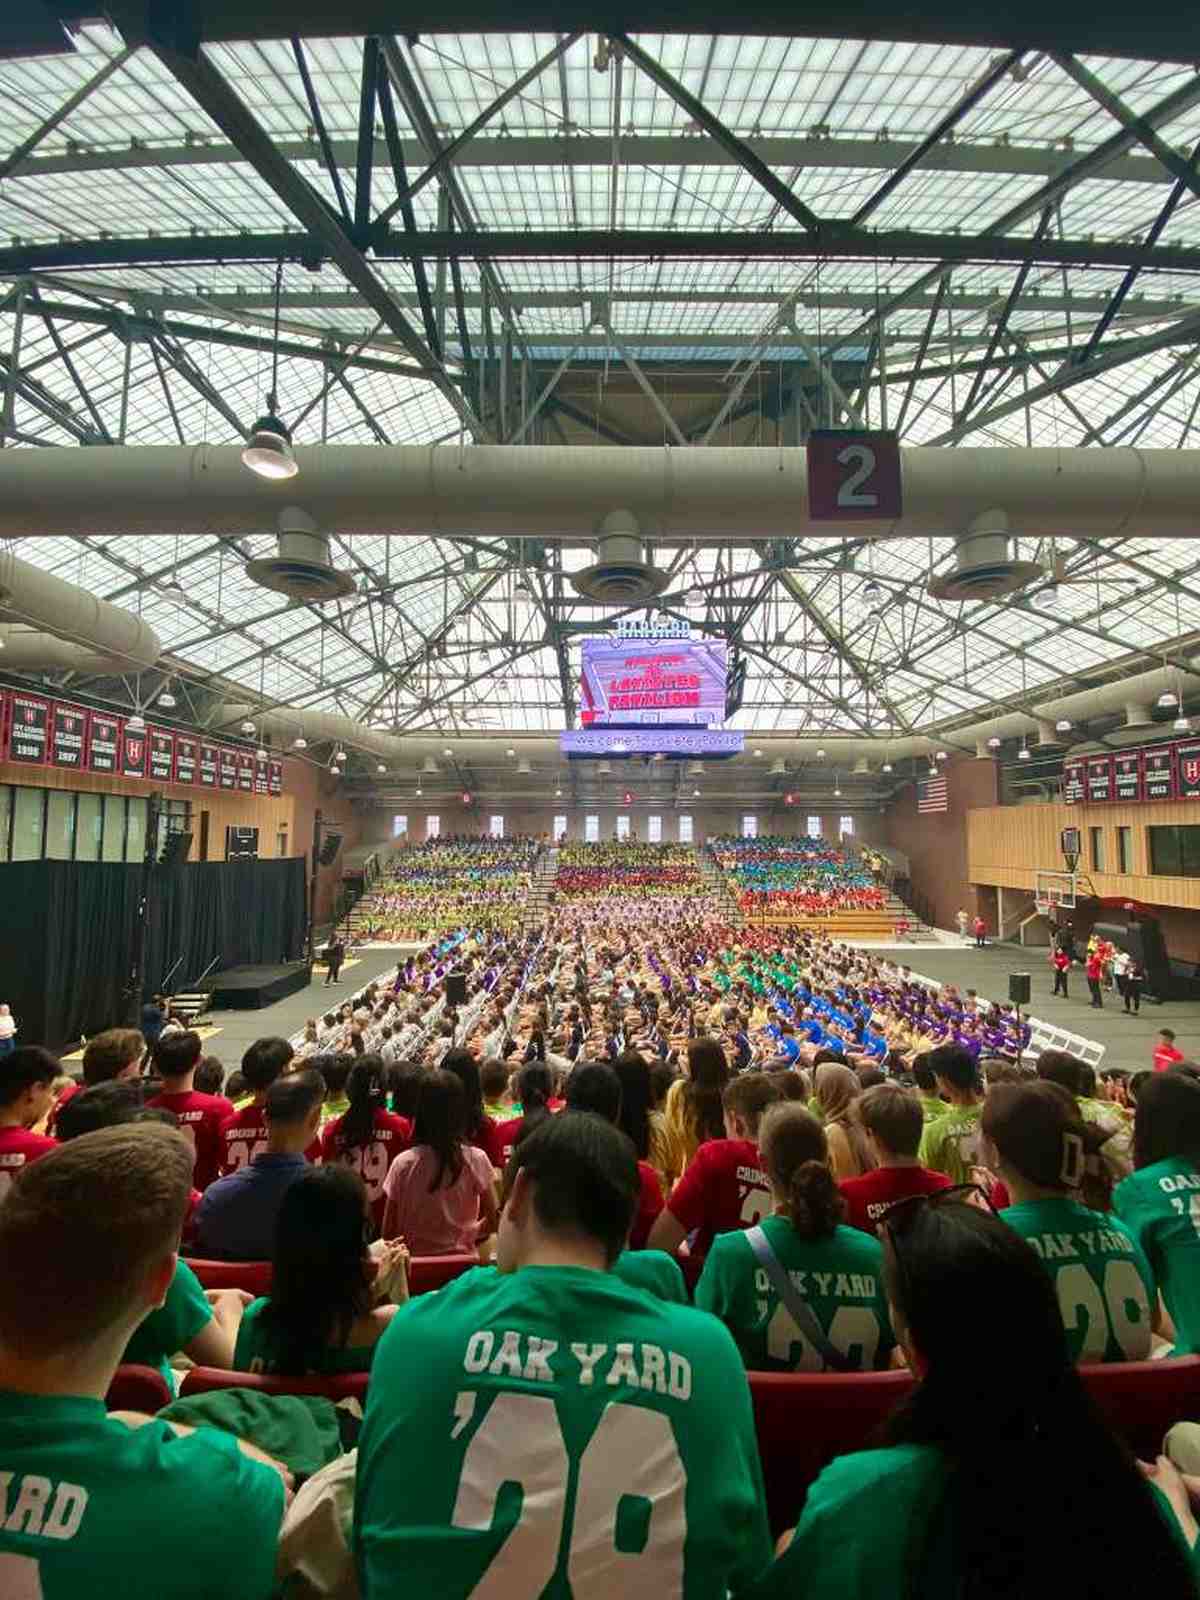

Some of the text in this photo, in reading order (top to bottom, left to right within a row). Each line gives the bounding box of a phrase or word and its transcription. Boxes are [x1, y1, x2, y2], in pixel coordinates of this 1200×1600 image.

[837, 444, 878, 506] 2
[1186, 761, 1198, 778] H
[755, 1268, 877, 1298] OK YARD
[464, 1331, 692, 1401] OAK YARD
